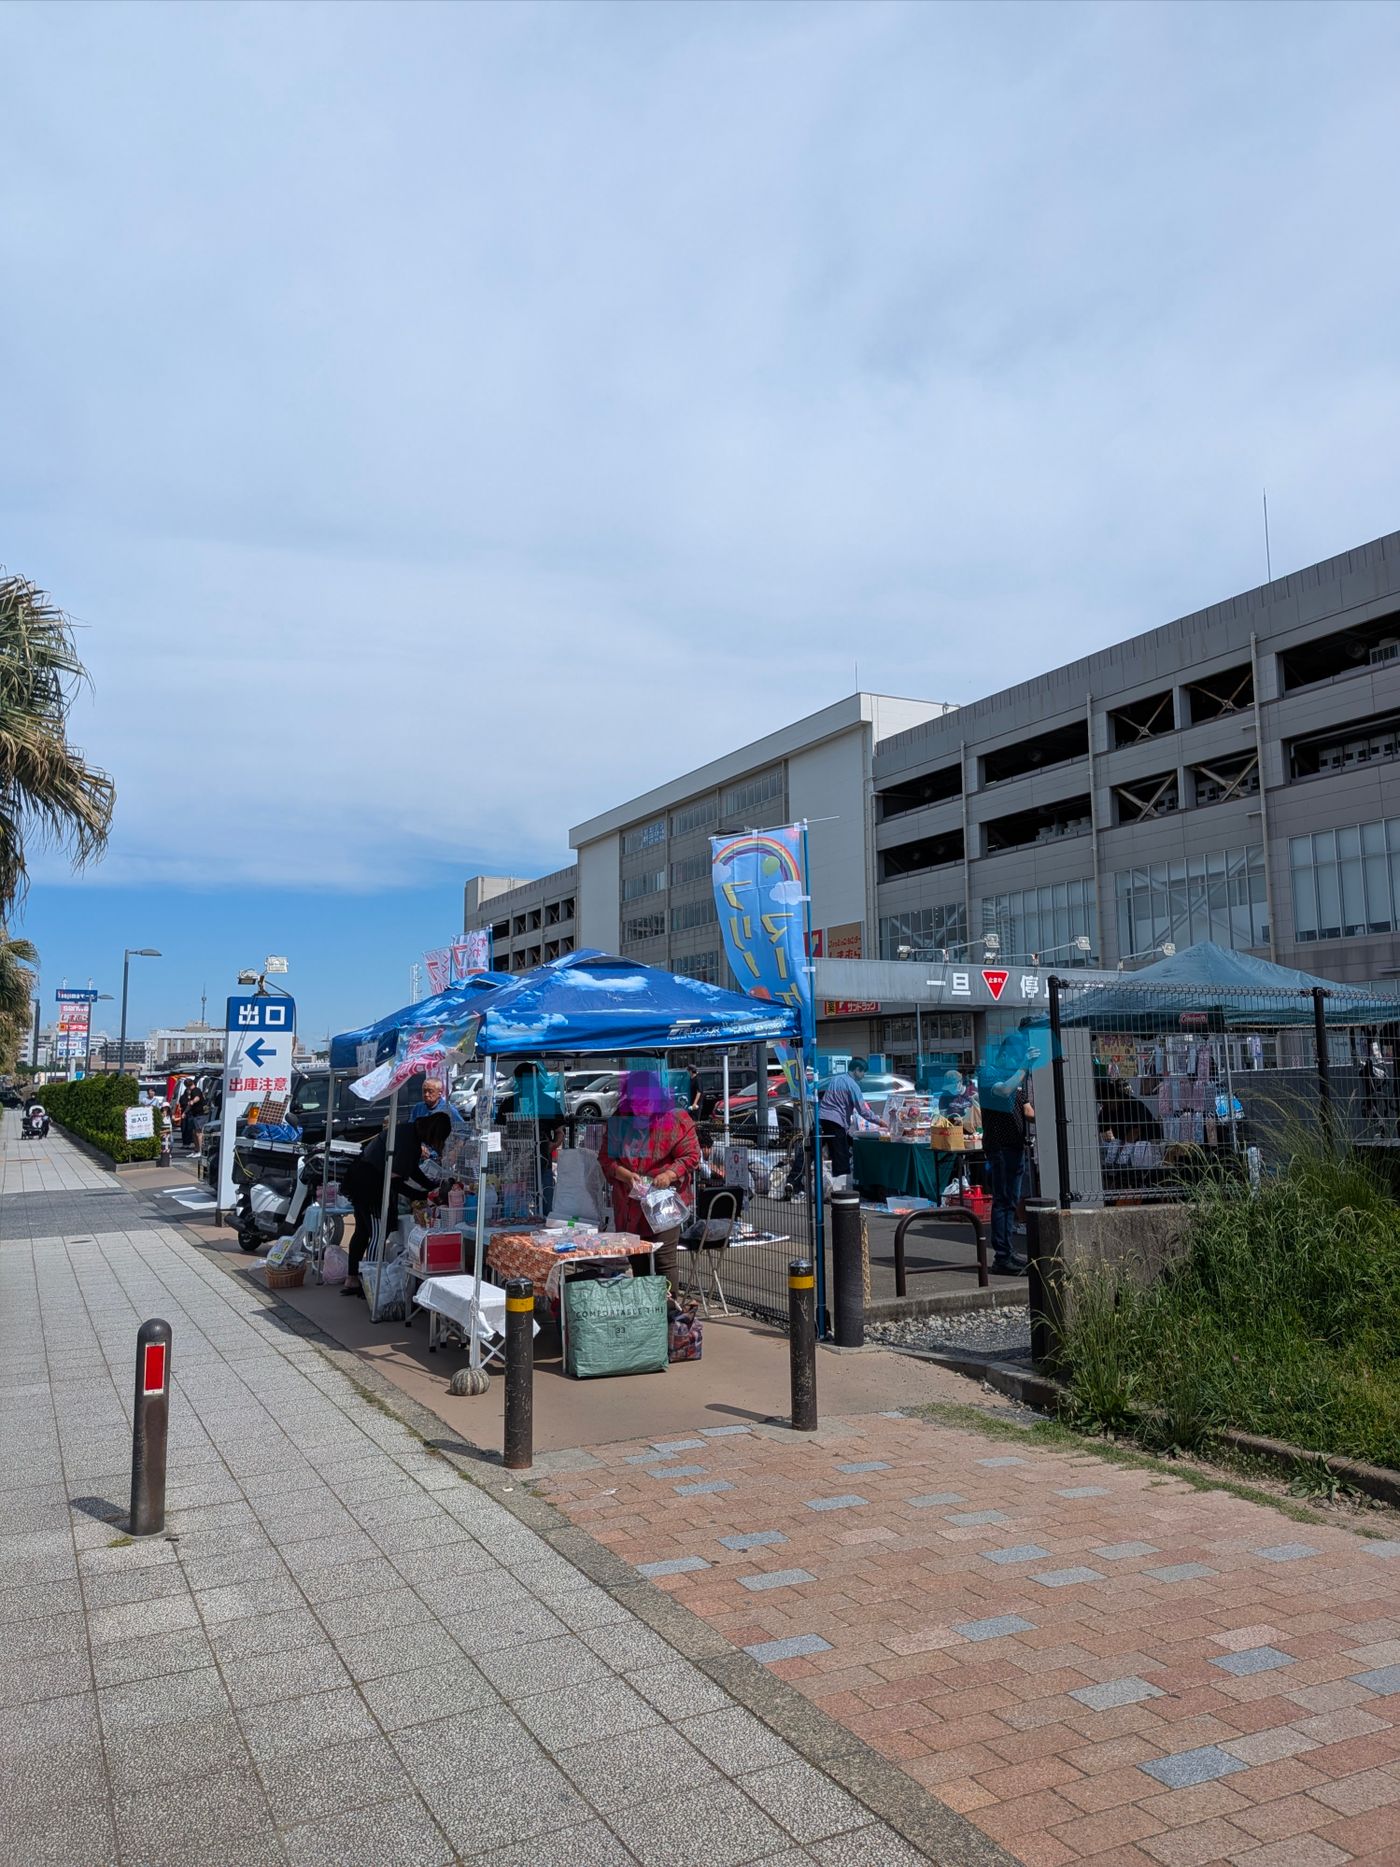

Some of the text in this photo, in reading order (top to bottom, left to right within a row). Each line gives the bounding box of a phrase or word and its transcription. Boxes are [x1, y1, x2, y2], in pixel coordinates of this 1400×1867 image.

[926, 972, 971, 996] 一旦
[238, 1004, 286, 1025] 出口
[229, 1077, 287, 1092] 出庫注意
